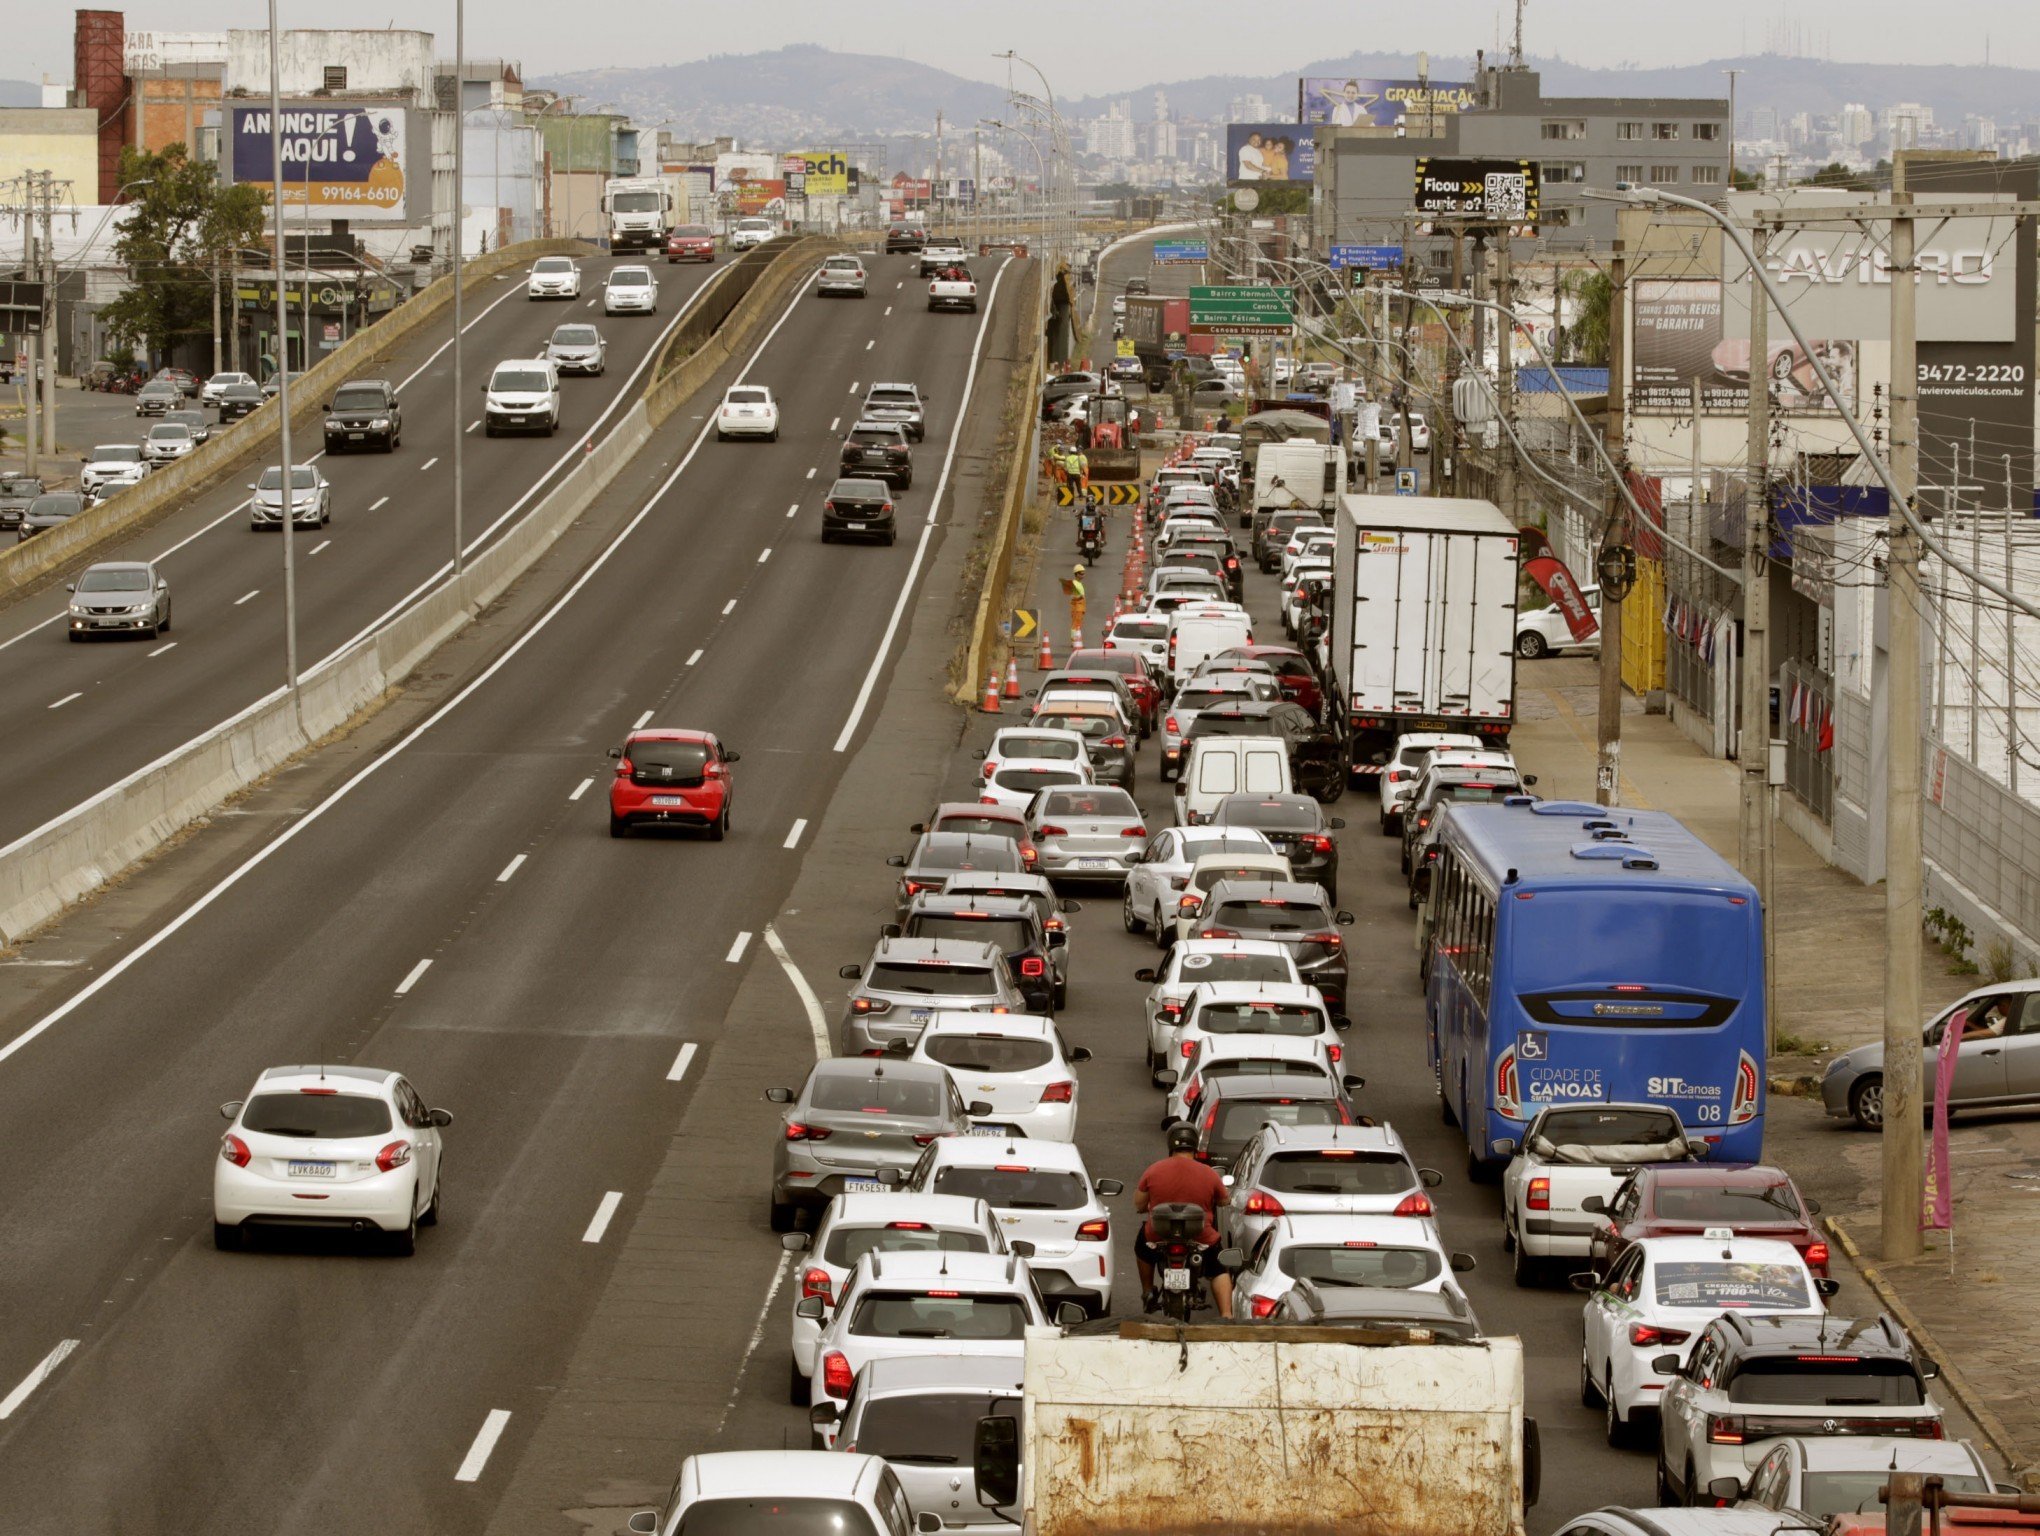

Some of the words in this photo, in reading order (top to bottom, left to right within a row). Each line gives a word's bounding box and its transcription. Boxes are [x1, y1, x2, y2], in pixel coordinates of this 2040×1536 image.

[1424, 177, 1459, 192] Ficou
[321, 186, 399, 201] 99164-6610
[1664, 304, 1687, 315] 100%
[1203, 314, 1228, 322] Bairro
[1231, 314, 1261, 322] Fátima
[1641, 318, 1654, 326] COM
[1656, 317, 1704, 330] GARANTIA
[1210, 326, 1239, 334] Canoas
[1240, 326, 1278, 336] Shopping
[1917, 364, 2025, 382] 3472-2220
[1917, 386, 2024, 396] favieroveiculos.com.br
[1530, 1067, 1580, 1082] CIDADE
[1584, 1068, 1601, 1082] DE
[1529, 1081, 1602, 1098] CANOAS
[1698, 1104, 1721, 1121] 08
